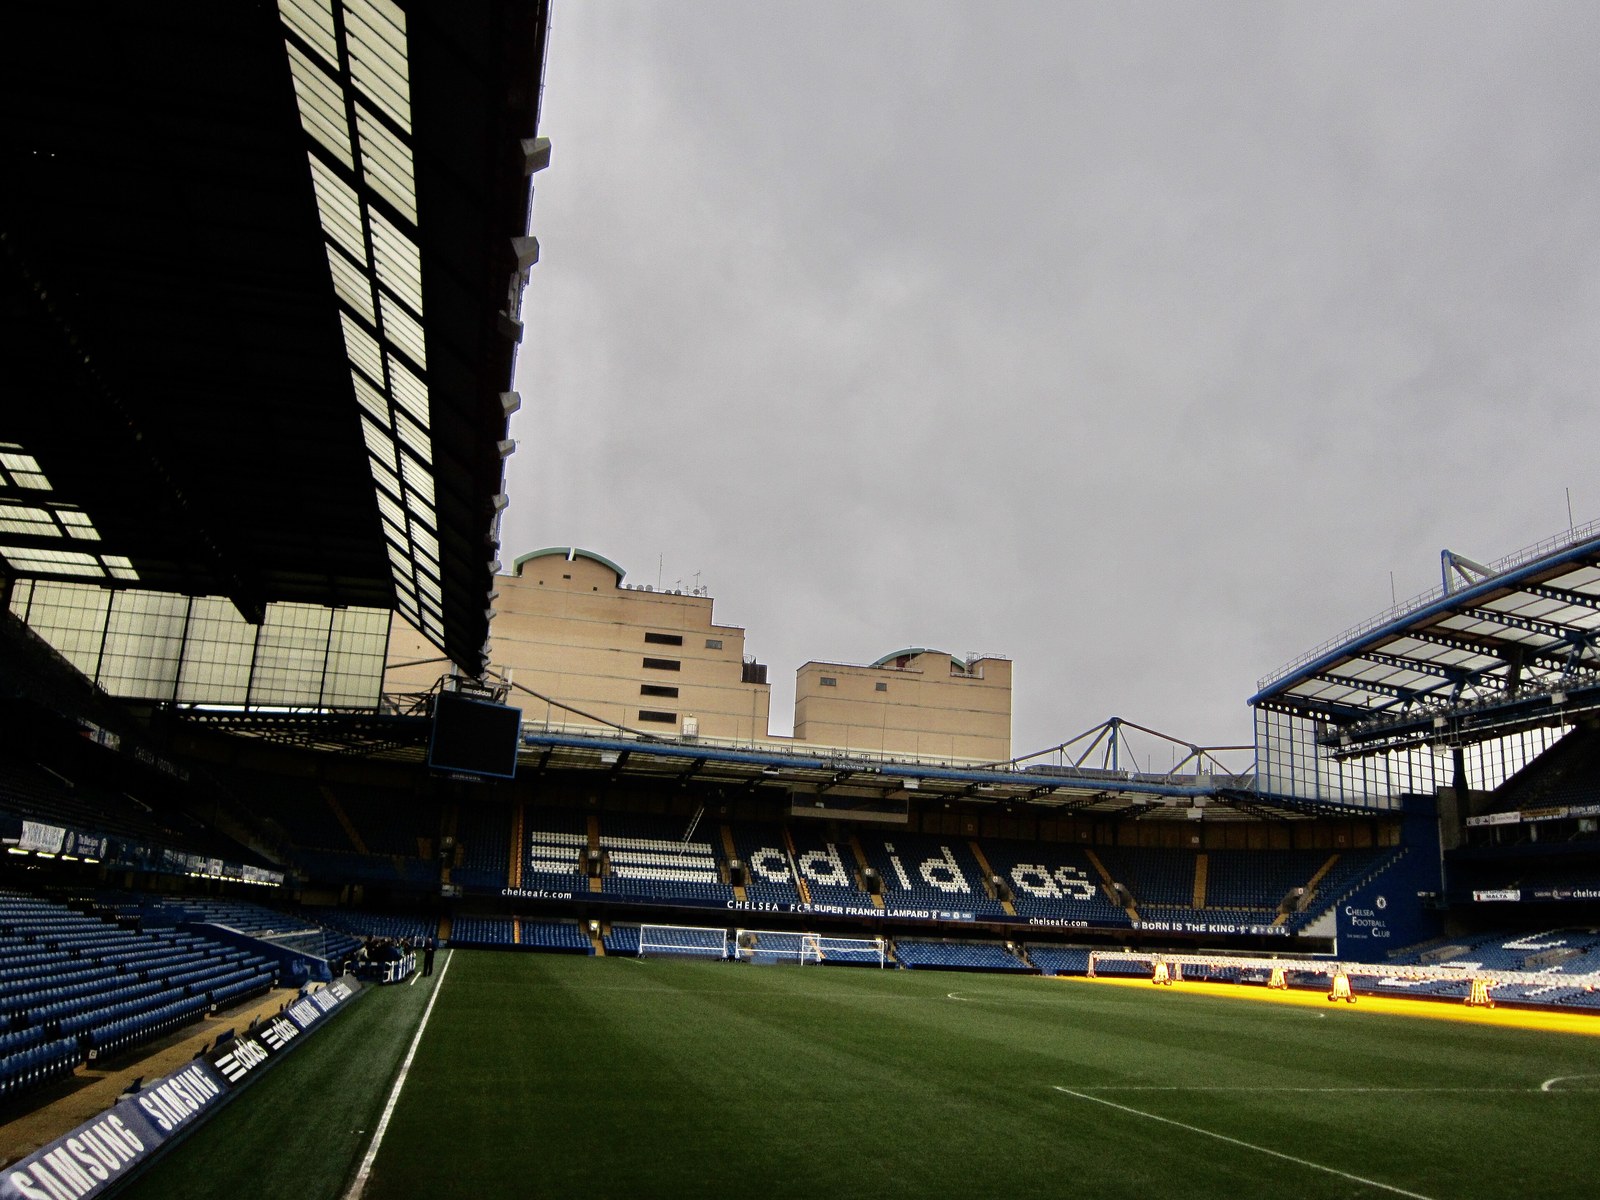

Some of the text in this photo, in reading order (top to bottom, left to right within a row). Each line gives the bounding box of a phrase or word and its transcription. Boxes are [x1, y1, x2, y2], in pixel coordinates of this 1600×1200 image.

[473, 689, 492, 698] adidas
[501, 887, 572, 899] chelseafc.com
[727, 900, 779, 912] CHELSEA
[814, 904, 843, 915] SUPER
[845, 907, 885, 917] FRANKIE
[887, 909, 929, 918] LAMPARD
[1345, 905, 1375, 917] CHELSEA
[1029, 917, 1088, 927] chelseafc.com
[1141, 921, 1235, 933] BORN IS THE KING
[1352, 916, 1386, 928] FOOTBALL
[1371, 927, 1391, 938] CLUB
[272, 1016, 300, 1043] adidas
[233, 1038, 269, 1070] adidas
[139, 1065, 220, 1131] SAMSUNG
[10, 1114, 145, 1200] SAMSUNG
